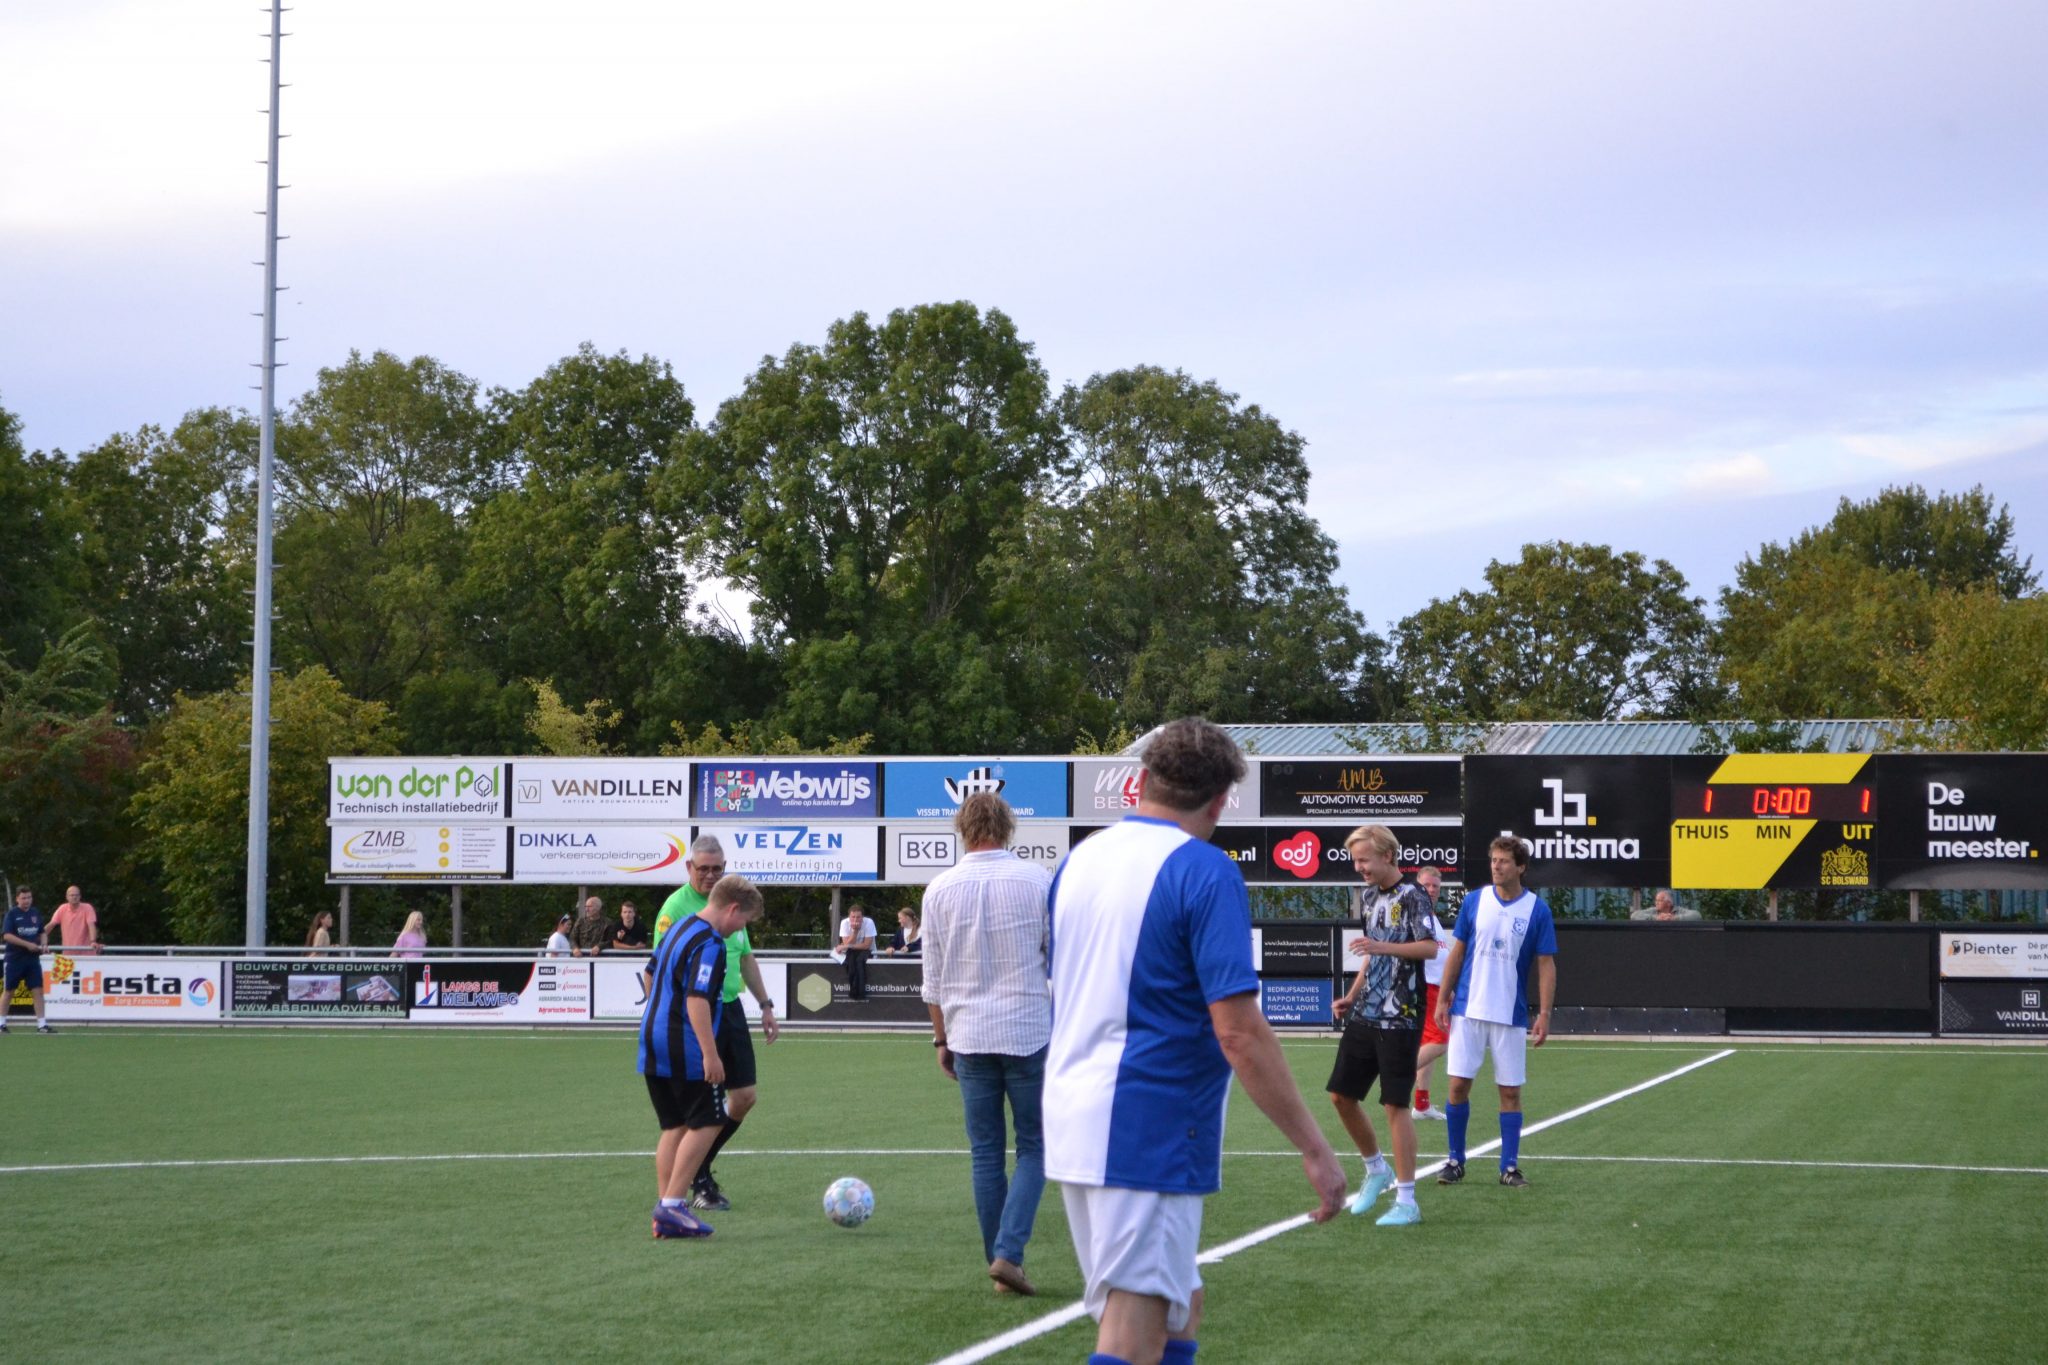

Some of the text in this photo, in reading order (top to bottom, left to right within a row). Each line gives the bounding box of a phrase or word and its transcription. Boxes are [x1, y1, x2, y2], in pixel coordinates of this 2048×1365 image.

[1337, 768, 1387, 791] AMB
[552, 779, 682, 796] VANDILLEN
[750, 770, 871, 805] Webwijs
[1928, 782, 1965, 805] De
[1301, 795, 1424, 804] AUTOMOTIVE BOLSWARD
[1704, 788, 1871, 814] 1 0:00 1
[337, 801, 499, 815] Technisch installatiebedrijf
[917, 808, 940, 816] VISSER
[1928, 808, 1996, 831] bouw
[363, 830, 405, 847] ZMB
[1675, 824, 1874, 840] THUIS MIN UIT
[519, 833, 597, 847] DINKLA
[735, 826, 842, 855] VELZEN
[540, 850, 661, 861] verkeersopleidingen
[907, 841, 948, 859] BKB
[1281, 841, 1313, 867] odj
[1928, 838, 2038, 858] meester.
[734, 859, 843, 872] textielreiniging
[1821, 876, 1868, 886] SC BOLSWARD
[1963, 942, 2018, 955] Pienter
[235, 963, 403, 972] BOUWEN OF VERBOUWEN??
[441, 981, 499, 993] LANGS DE
[864, 983, 908, 992] Betaalbaar
[441, 992, 518, 1007] MELKWEG
